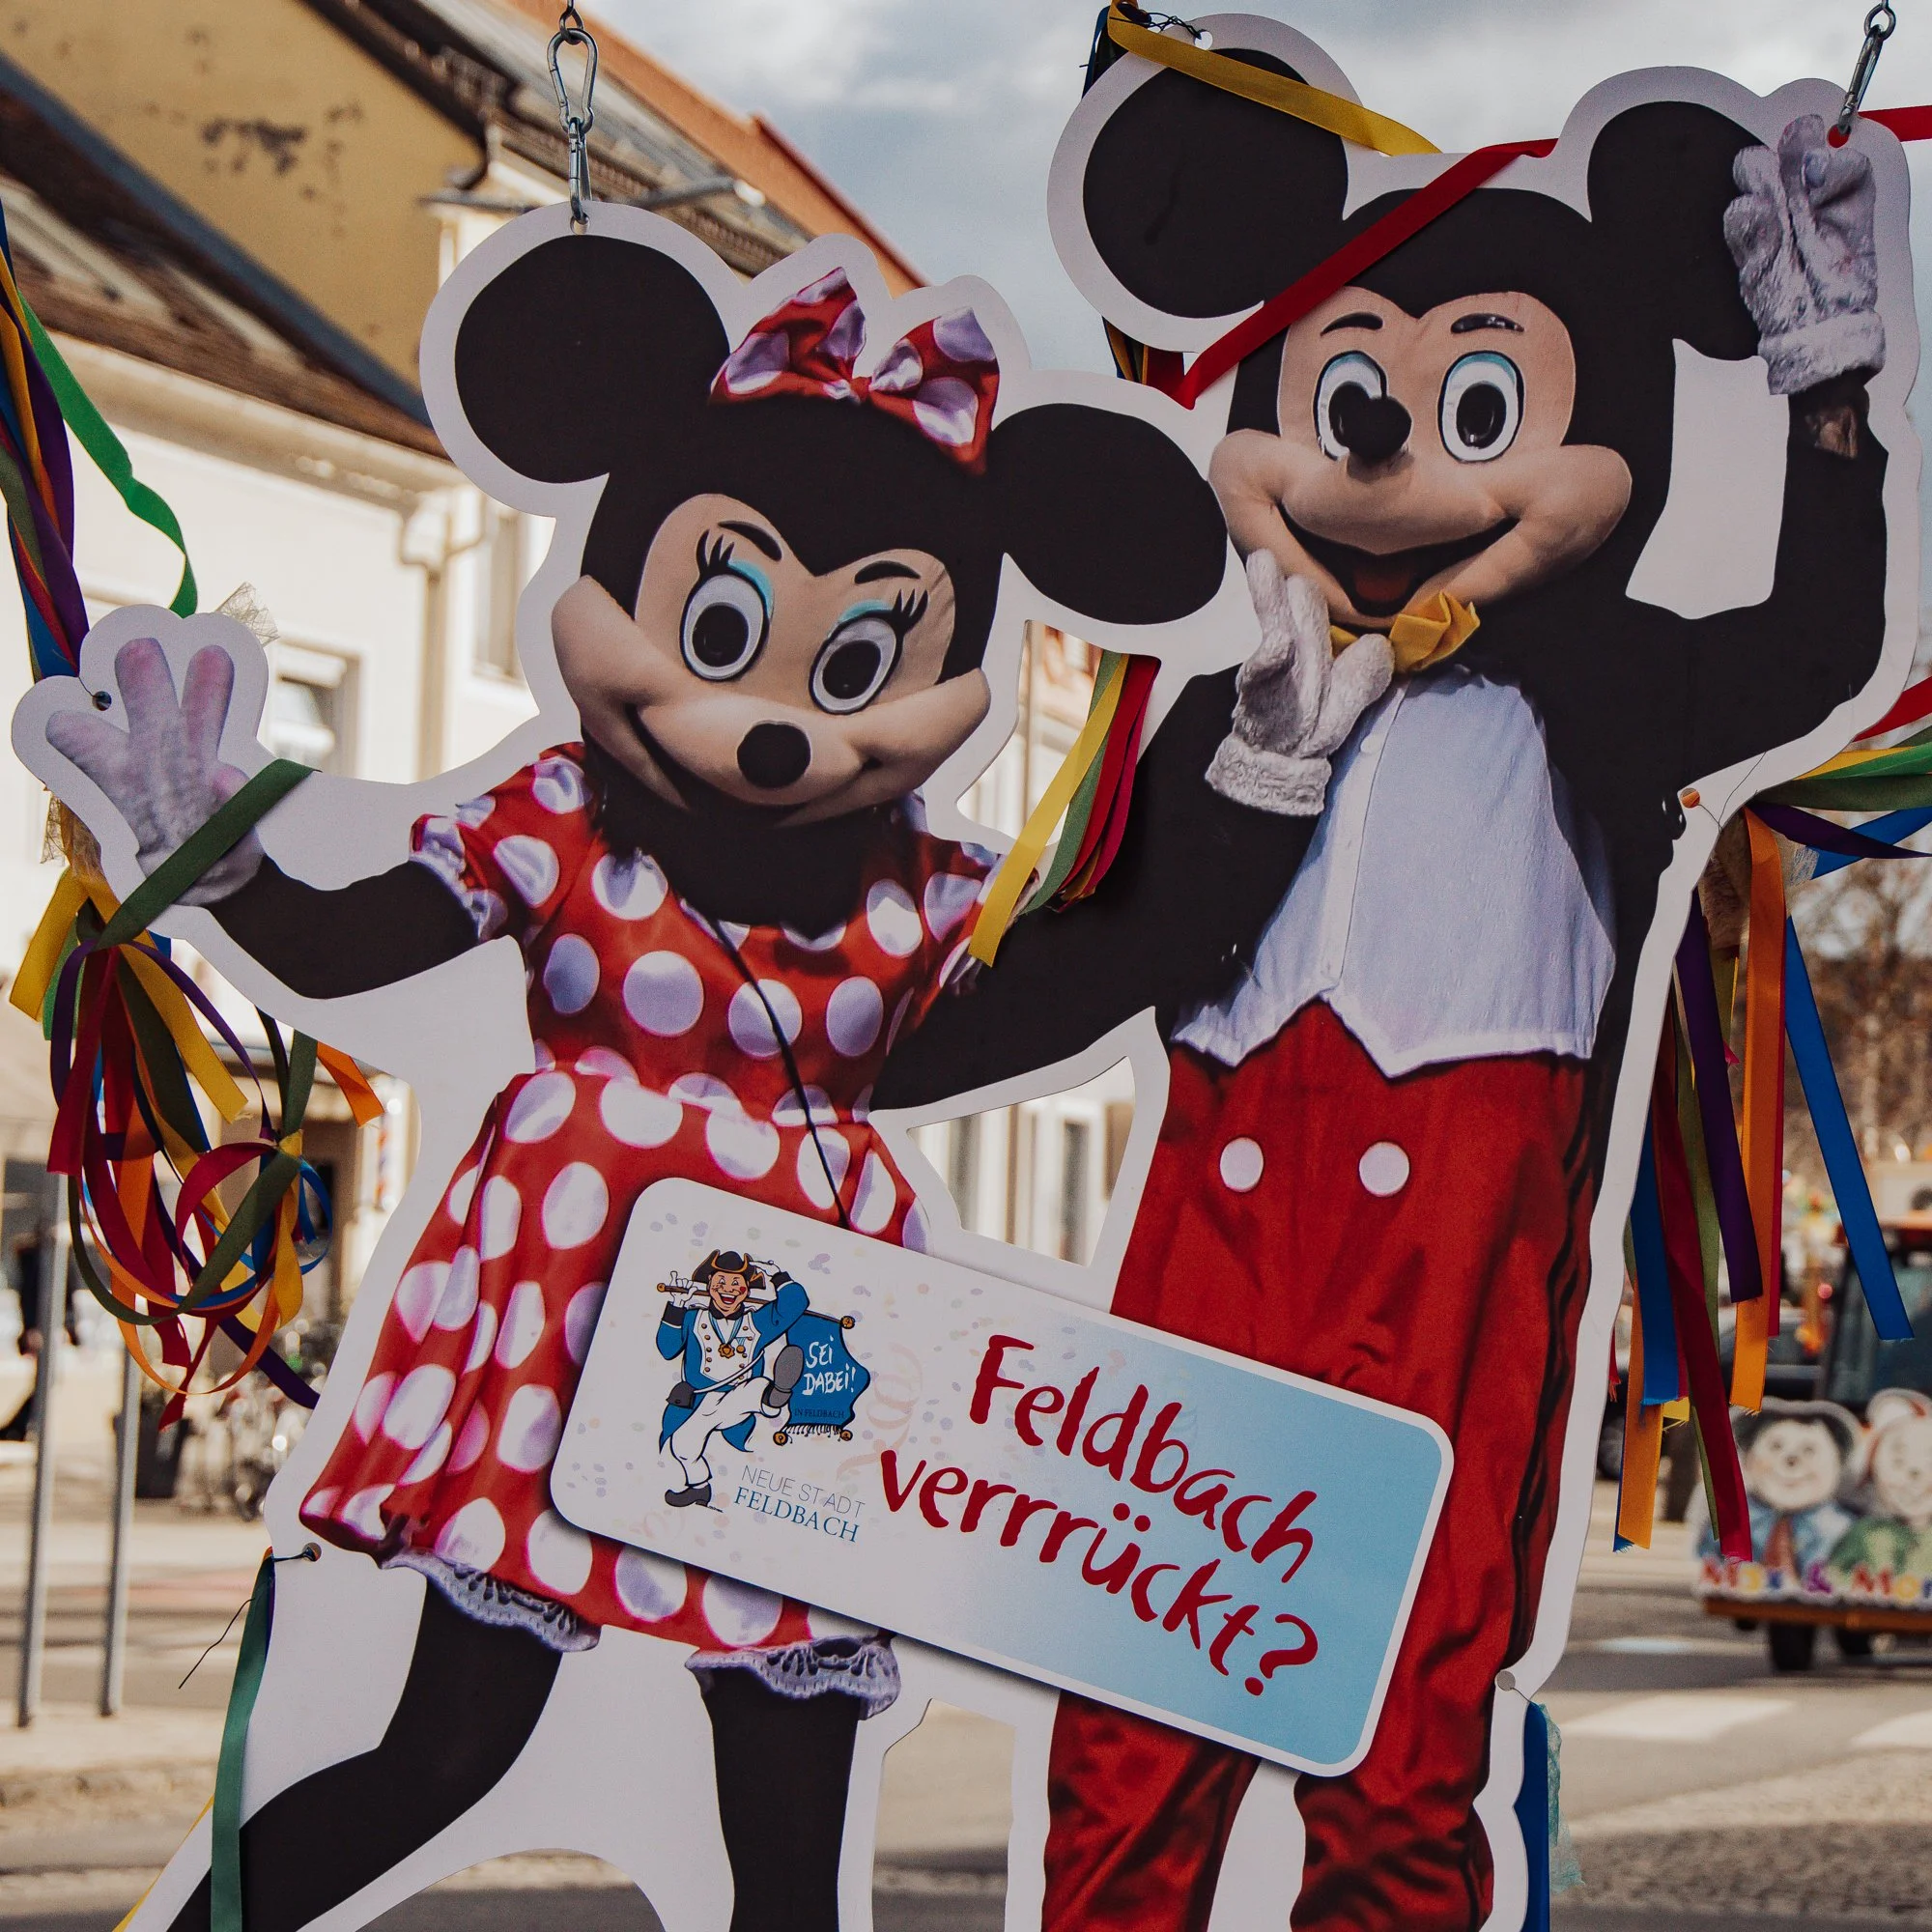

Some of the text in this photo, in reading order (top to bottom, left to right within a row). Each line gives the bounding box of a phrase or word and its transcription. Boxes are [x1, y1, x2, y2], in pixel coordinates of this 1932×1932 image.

[794, 1408, 845, 1419] IN FELDBACH
[969, 1334, 1317, 1584] Feldbach
[734, 1486, 860, 1543] FELDBACH
[741, 1464, 866, 1519] NEUE STADT
[880, 1449, 1319, 1696] verrrückt?
